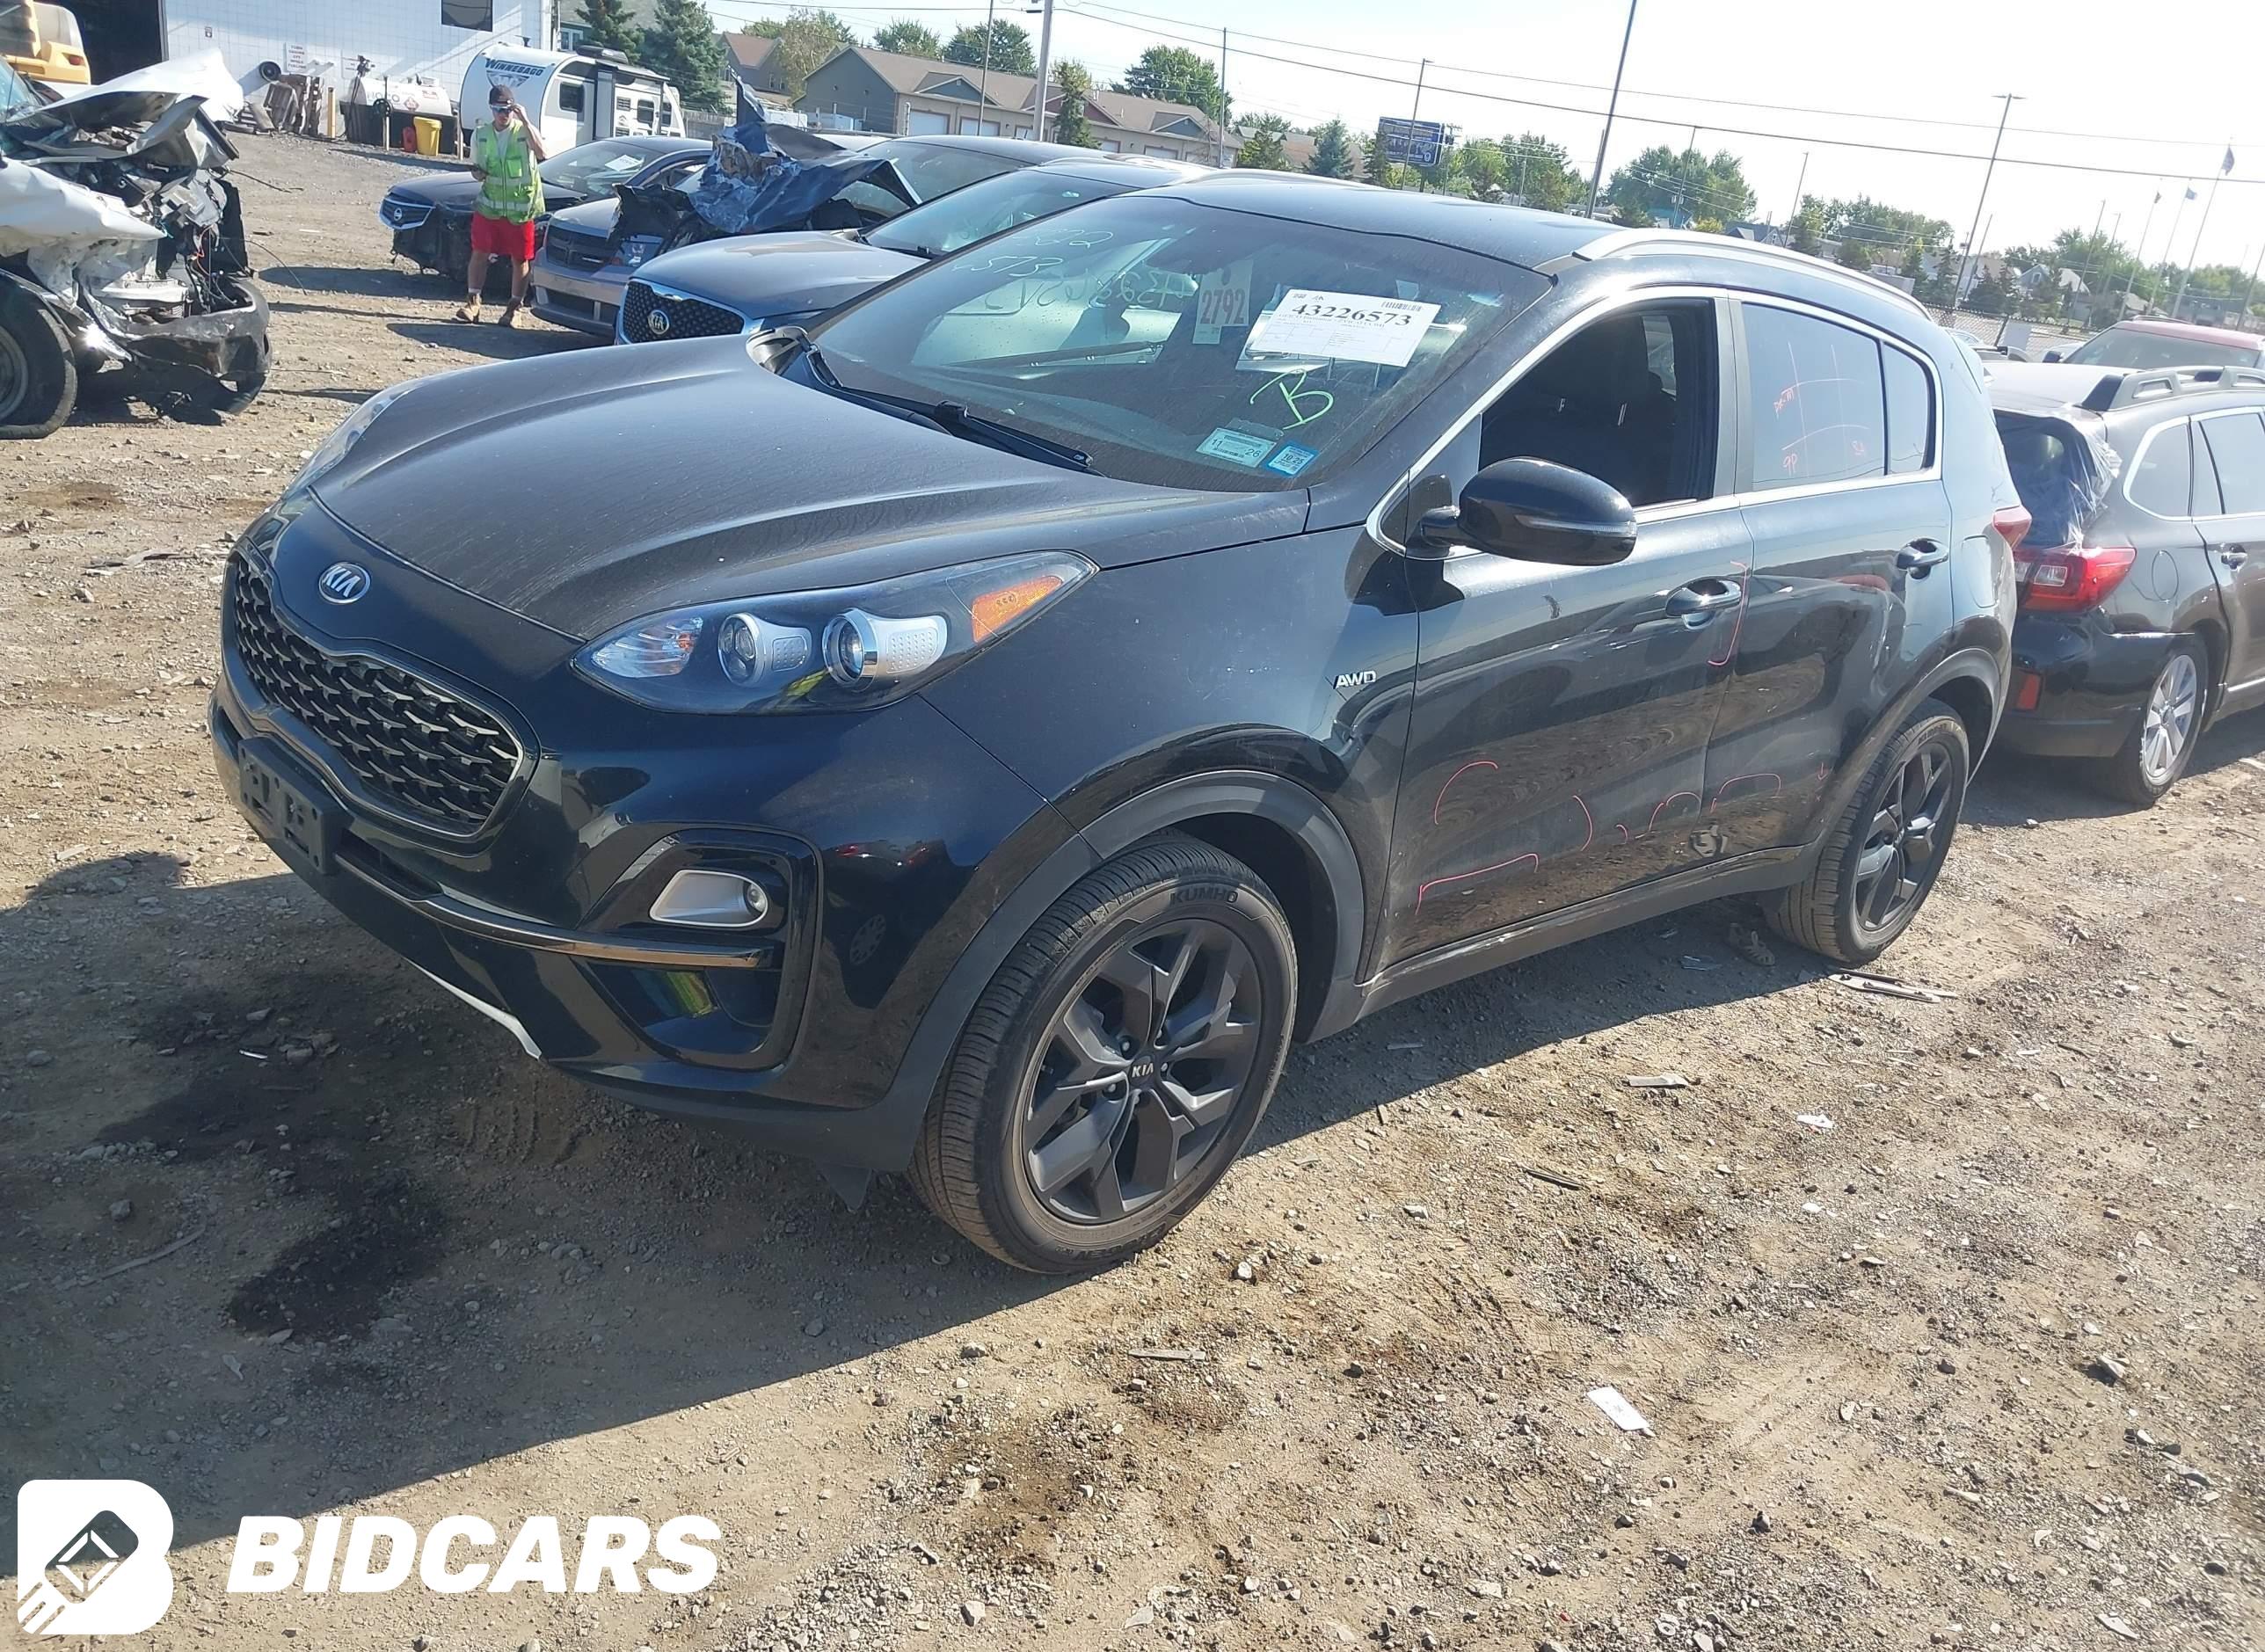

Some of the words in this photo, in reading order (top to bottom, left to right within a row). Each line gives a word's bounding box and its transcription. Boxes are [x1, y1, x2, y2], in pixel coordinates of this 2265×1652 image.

[485, 58, 545, 76] WINNEBAGO
[1200, 288, 1245, 324] 2792
[1293, 303, 1411, 326] 43226573
[1212, 440, 1223, 449] 11
[1245, 448, 1262, 458] 26
[322, 565, 361, 598] KIA
[1334, 670, 1377, 689] AWD
[1169, 886, 1238, 906] KUMHO
[1132, 1062, 1154, 1078] KIA
